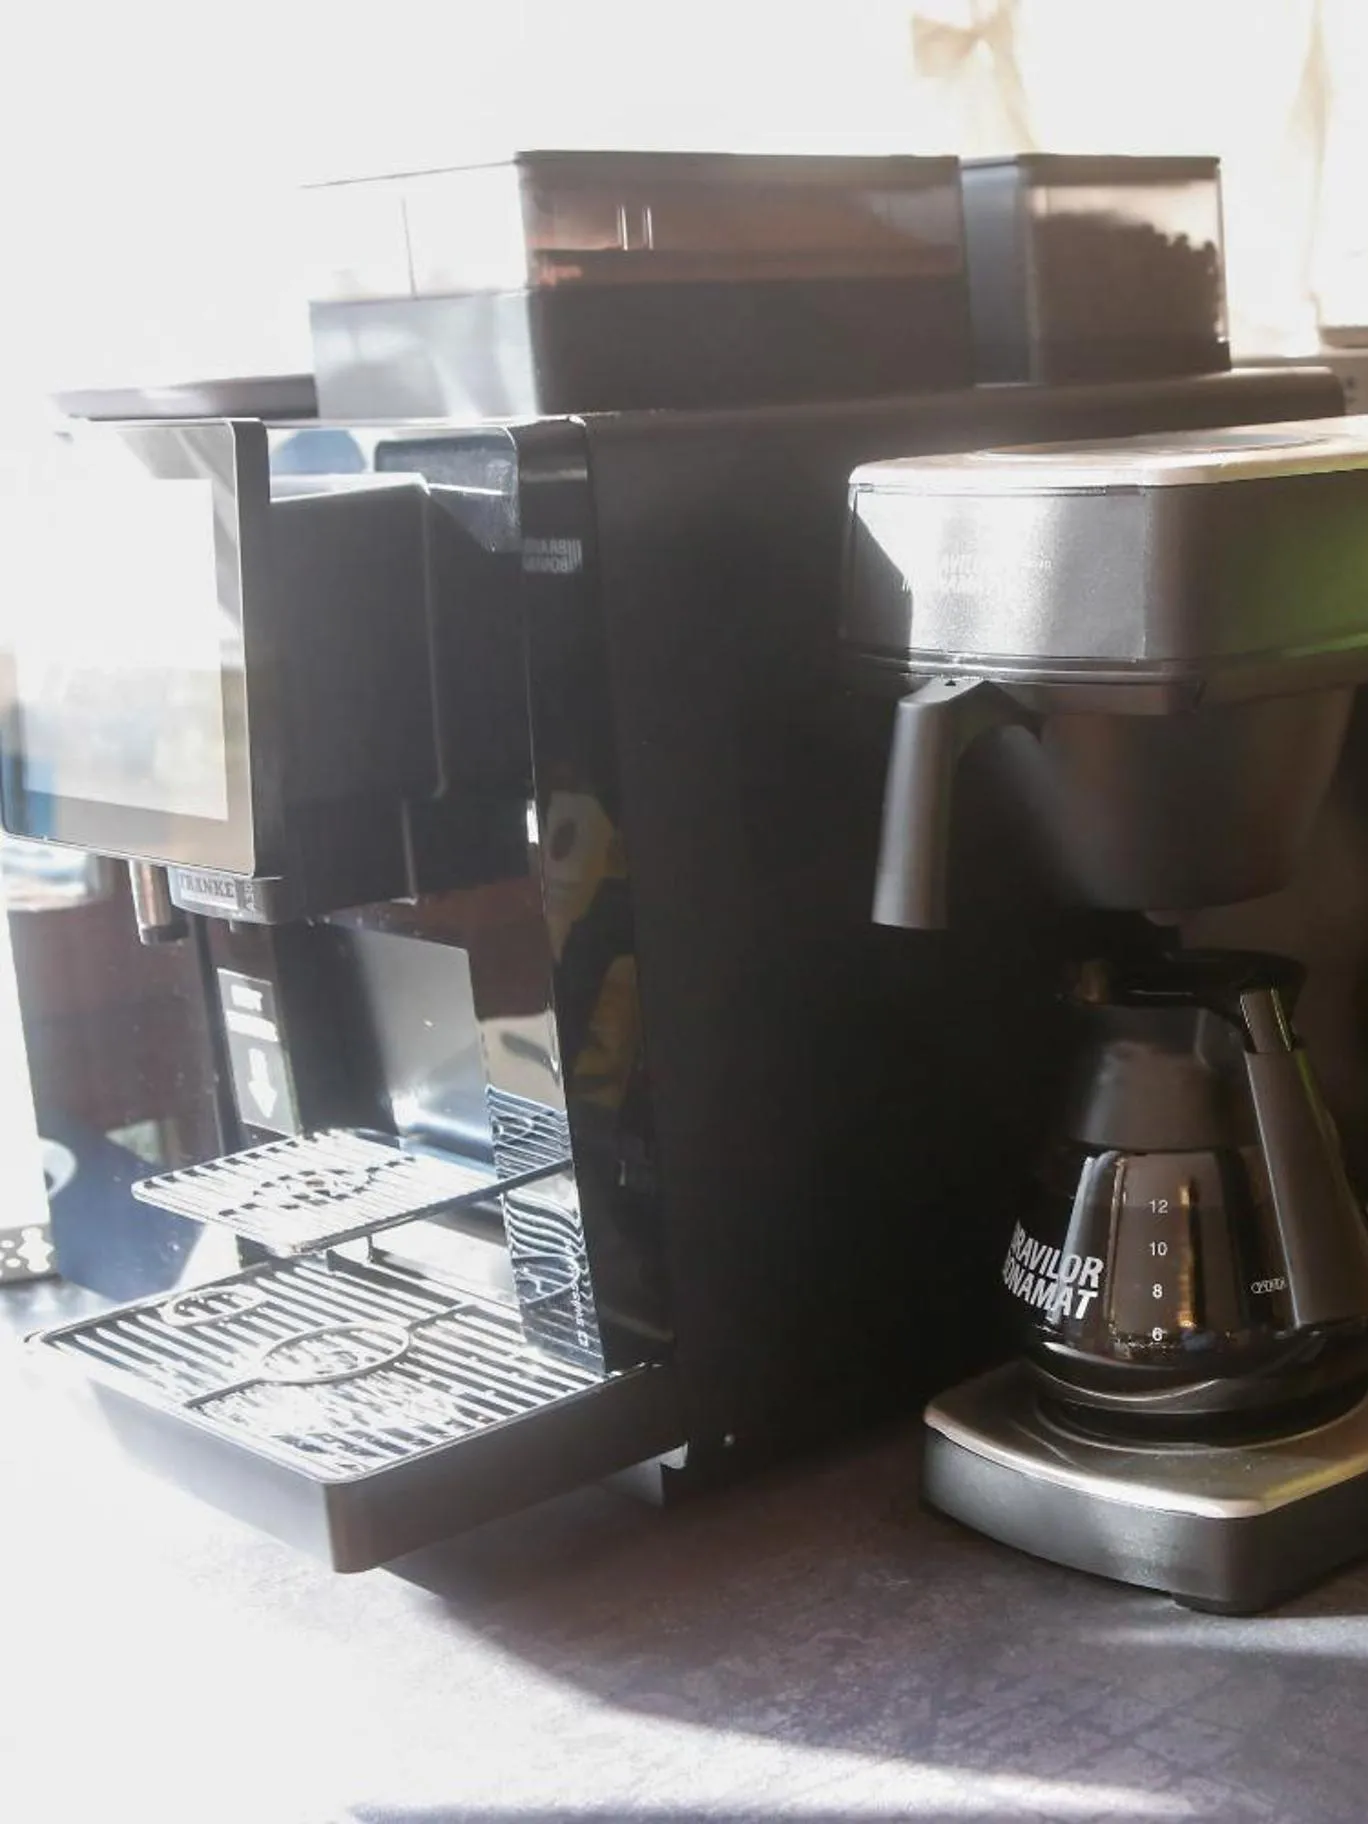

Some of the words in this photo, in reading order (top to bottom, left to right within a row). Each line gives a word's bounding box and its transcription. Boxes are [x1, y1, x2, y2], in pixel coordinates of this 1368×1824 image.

[1150, 1200, 1168, 1214] 12
[1150, 1241, 1168, 1256] 10
[1152, 1283, 1163, 1299] 8
[1152, 1327, 1163, 1342] 6
